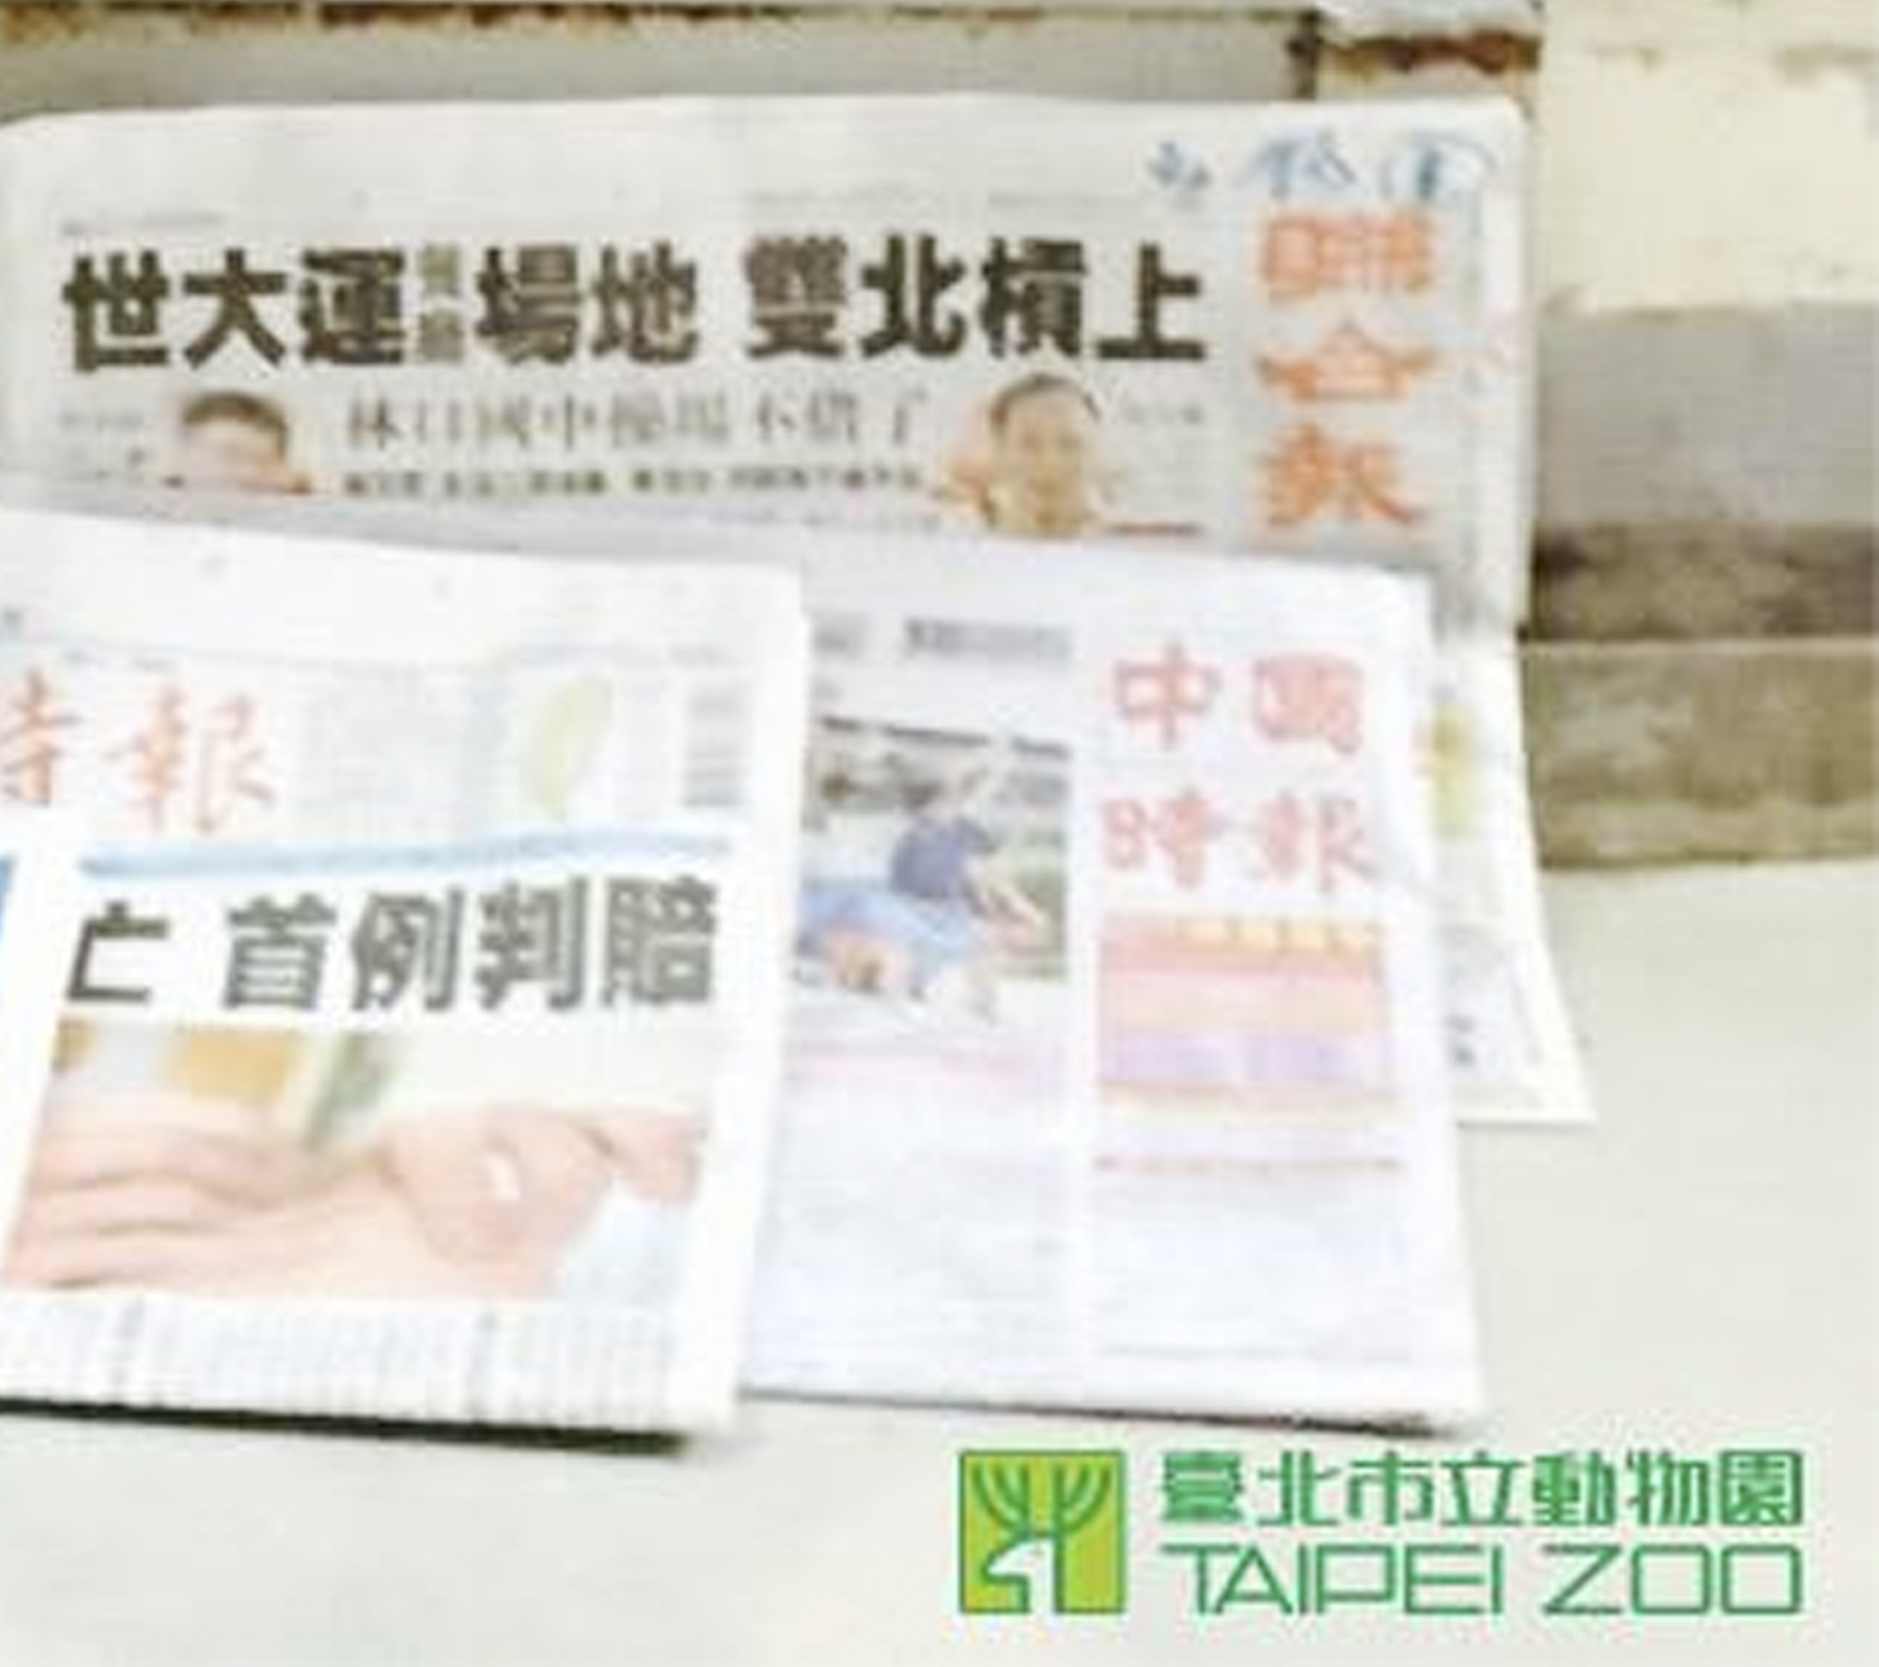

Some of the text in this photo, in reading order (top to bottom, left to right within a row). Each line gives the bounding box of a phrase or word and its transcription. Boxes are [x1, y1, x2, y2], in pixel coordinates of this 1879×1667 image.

[743, 234, 1206, 362] 雙北槓上
[220, 873, 719, 1012] 首例判賠
